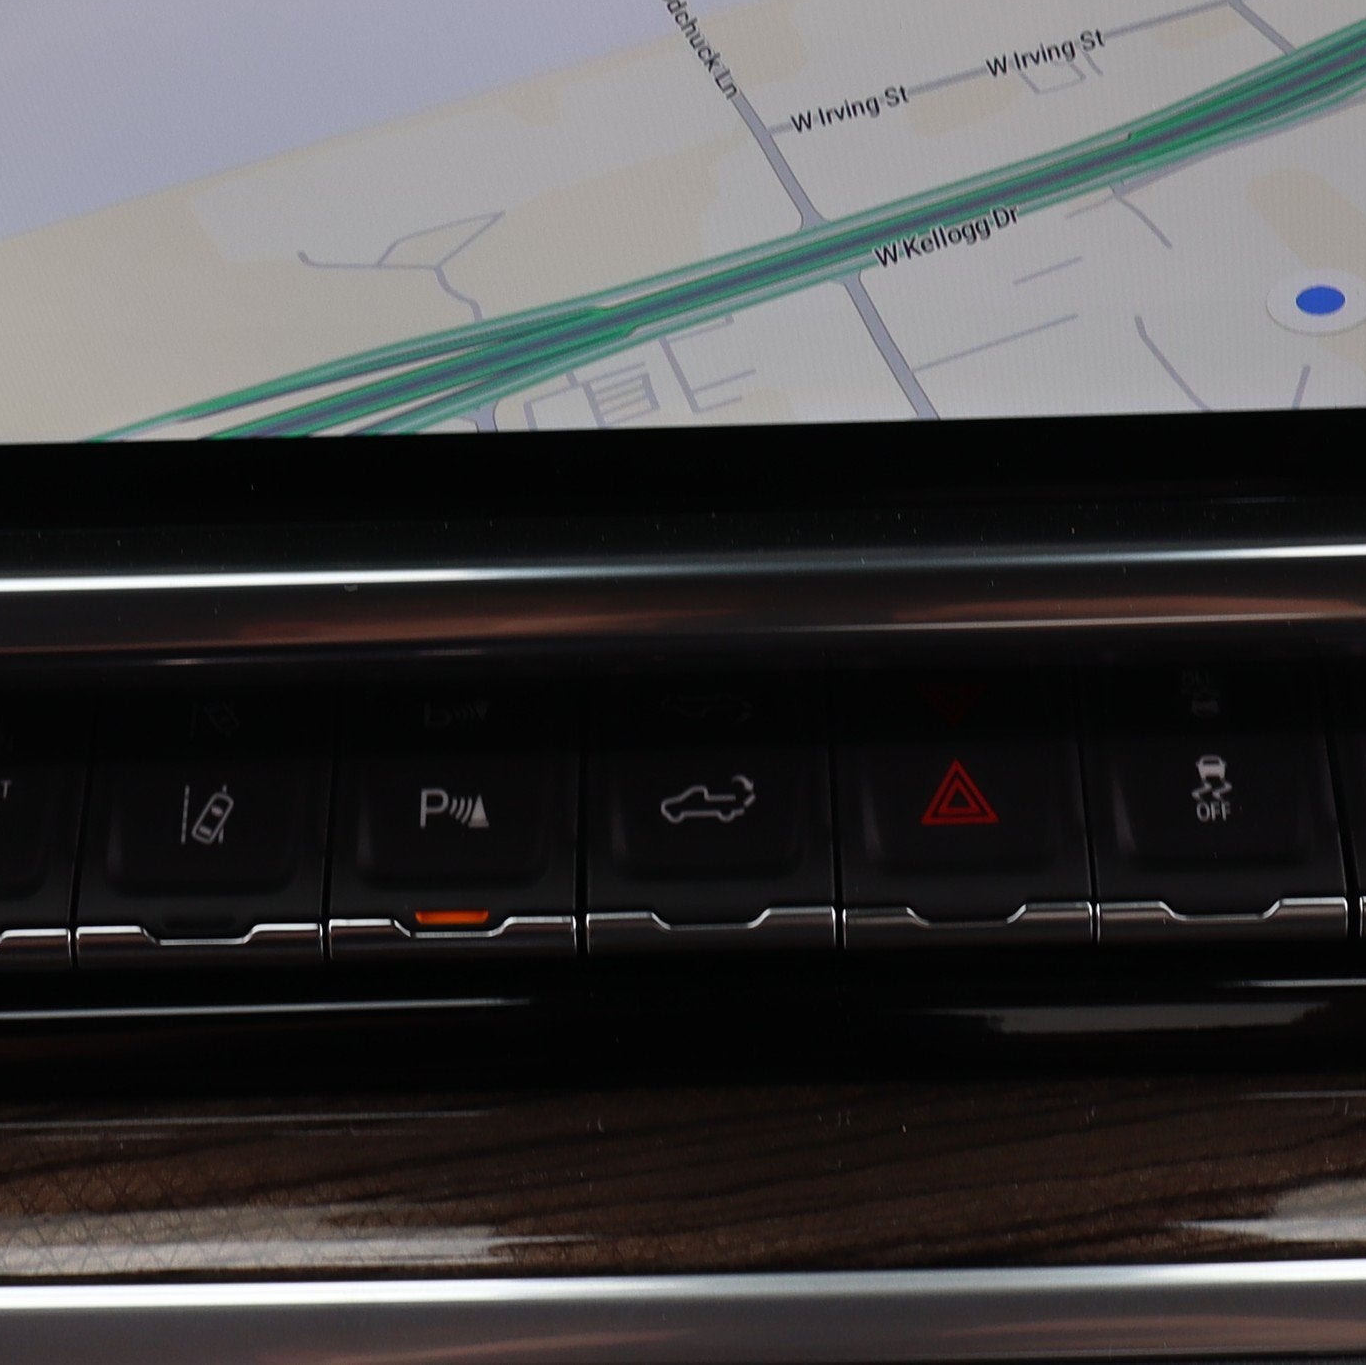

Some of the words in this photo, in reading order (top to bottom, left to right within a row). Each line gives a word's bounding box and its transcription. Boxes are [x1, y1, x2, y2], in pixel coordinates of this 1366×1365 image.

[984, 55, 1008, 78] W
[1013, 38, 1076, 71] Irving
[1079, 28, 1106, 51] St
[714, 66, 739, 101] Ln
[790, 110, 813, 134] W
[818, 94, 881, 128] Irving
[884, 84, 910, 107] St
[873, 243, 899, 268] W
[902, 215, 991, 260] Kellogg
[993, 205, 1020, 227] Dr
[419, 787, 449, 829] P
[1196, 800, 1232, 823] OFF
